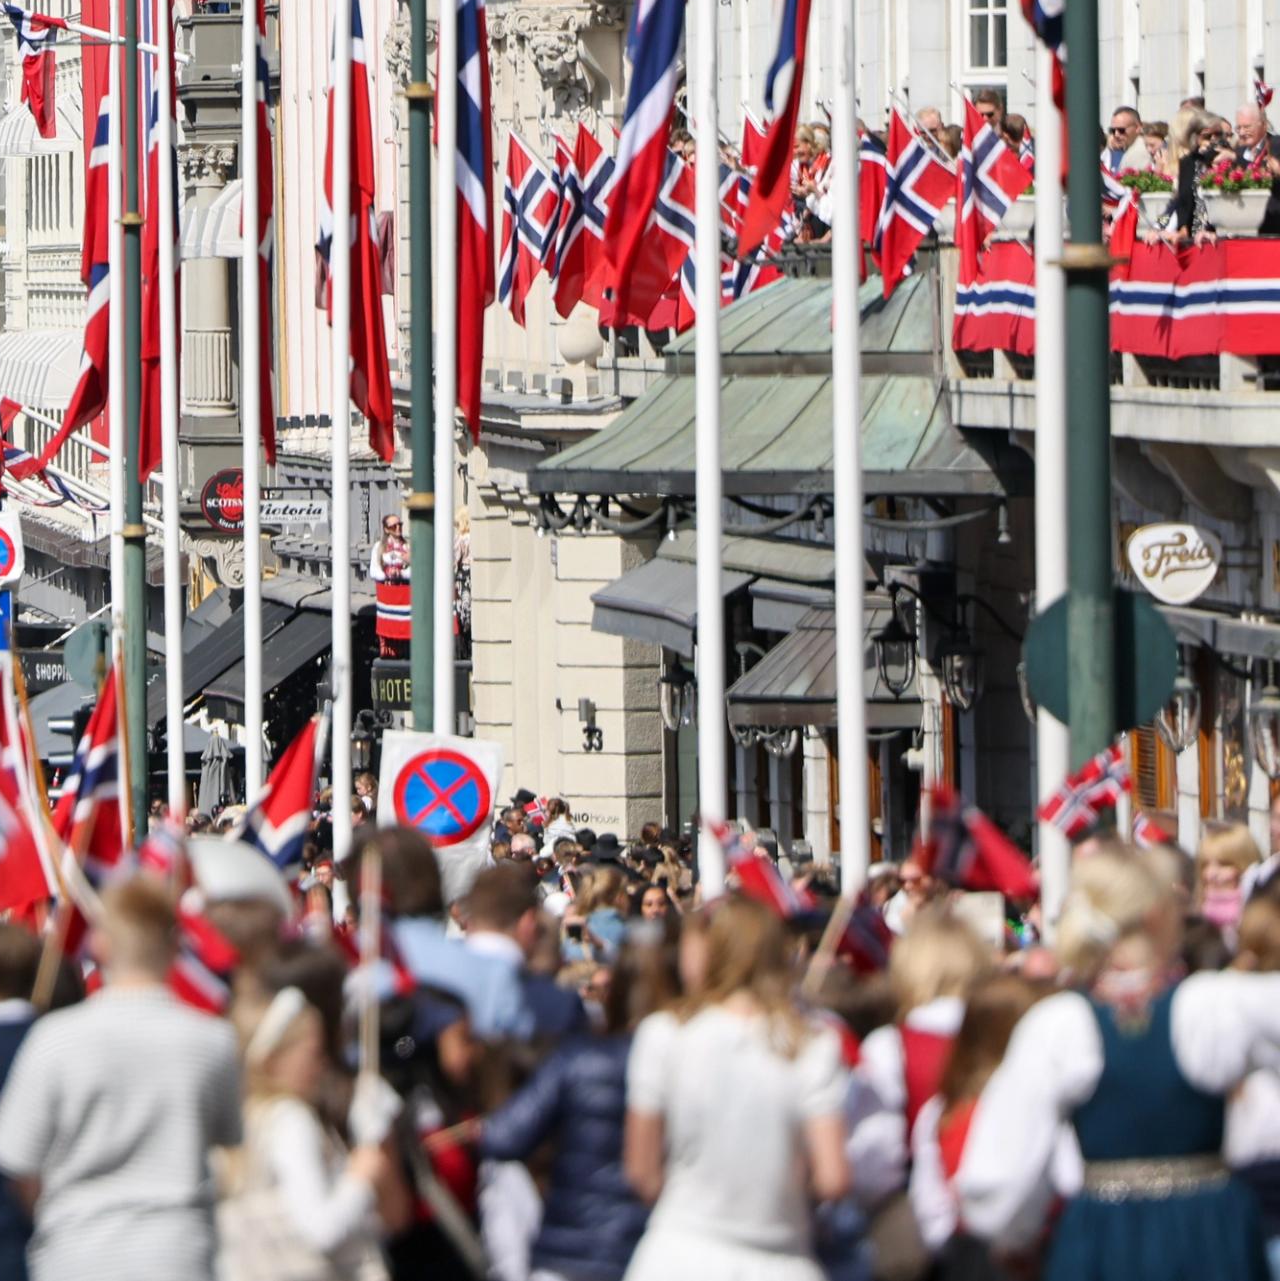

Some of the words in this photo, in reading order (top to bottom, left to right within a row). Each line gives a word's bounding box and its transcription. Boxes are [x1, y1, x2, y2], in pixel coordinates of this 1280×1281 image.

[1142, 532, 1216, 581] Freia
[380, 679, 412, 702] HOTE
[582, 726, 603, 752] 33
